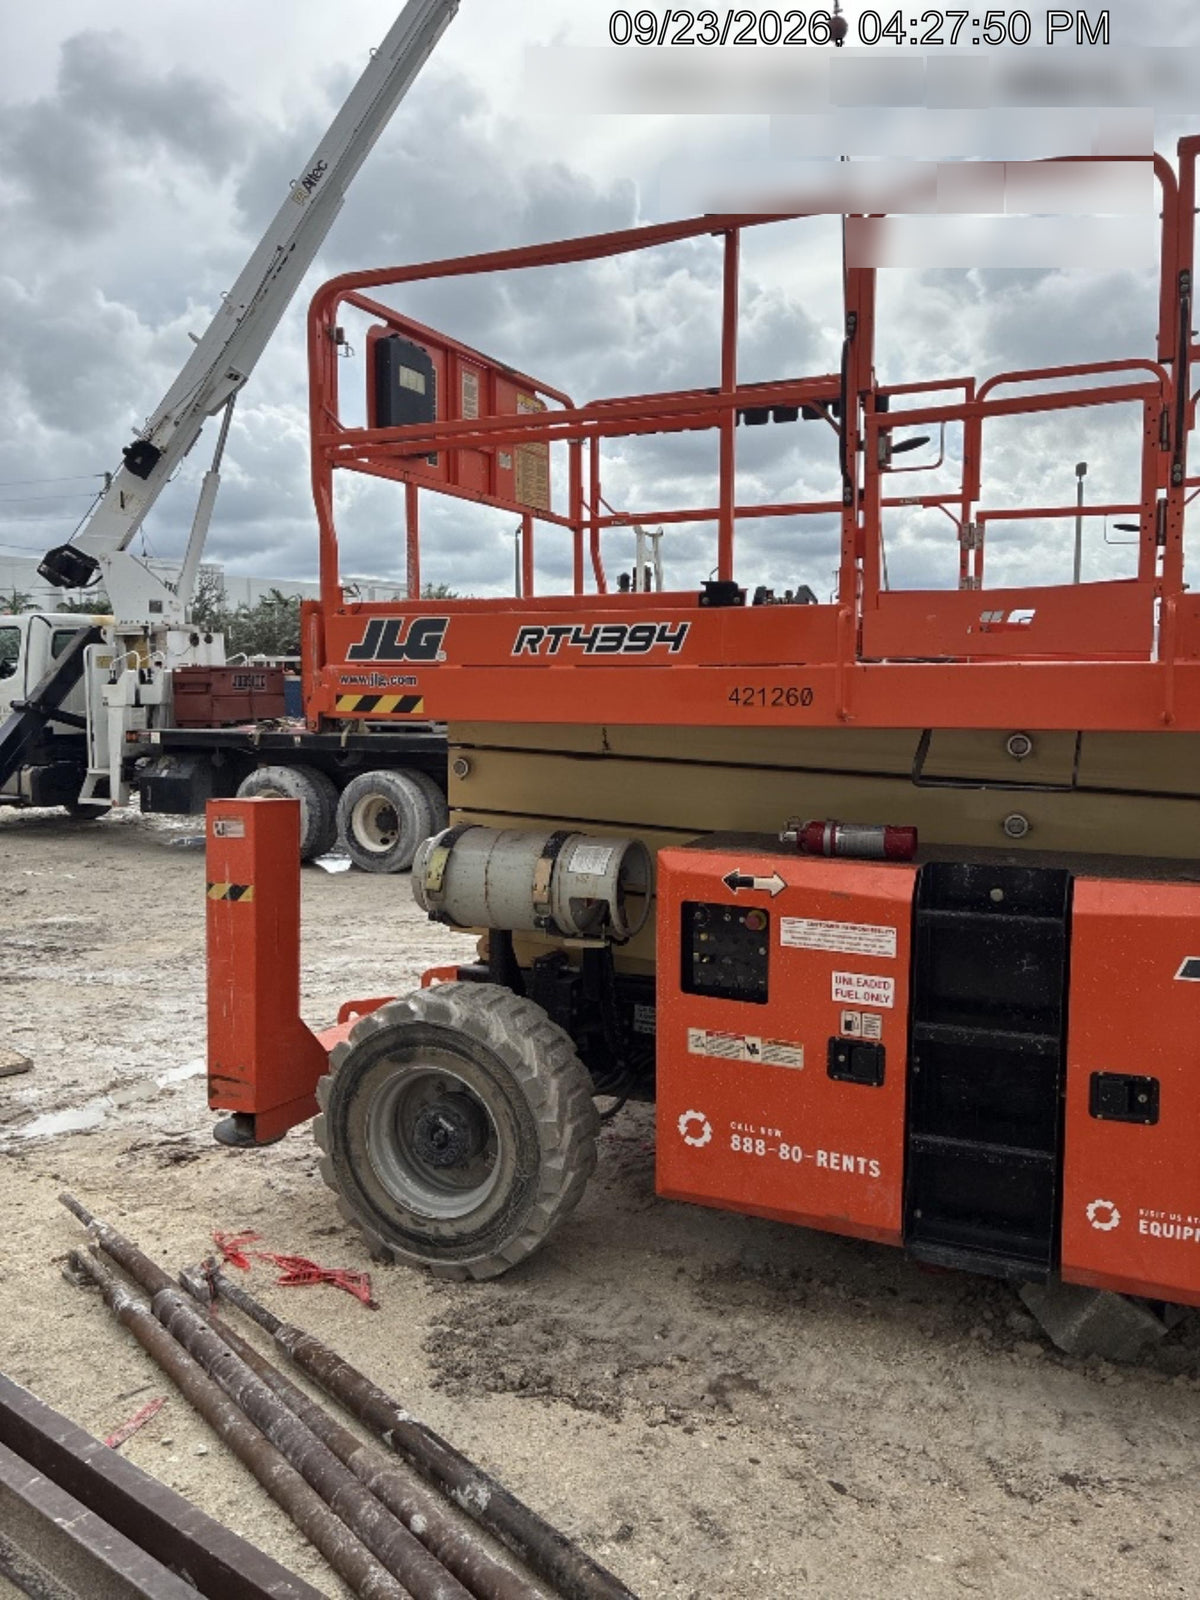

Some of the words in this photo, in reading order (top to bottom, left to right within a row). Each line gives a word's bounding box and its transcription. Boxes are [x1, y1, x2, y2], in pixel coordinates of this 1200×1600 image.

[344, 616, 451, 662] JLG
[511, 621, 692, 656] RT4394
[339, 671, 419, 688] www.jlg.com
[728, 686, 814, 707] 421260
[835, 975, 891, 991] UNLEADED
[835, 987, 860, 1000] FUEL
[863, 991, 891, 1004] ONLY
[730, 1121, 756, 1133] CALL
[759, 1126, 783, 1138] NOW
[730, 1133, 881, 1178] 888-80-RENTS
[1169, 1213, 1182, 1222] US
